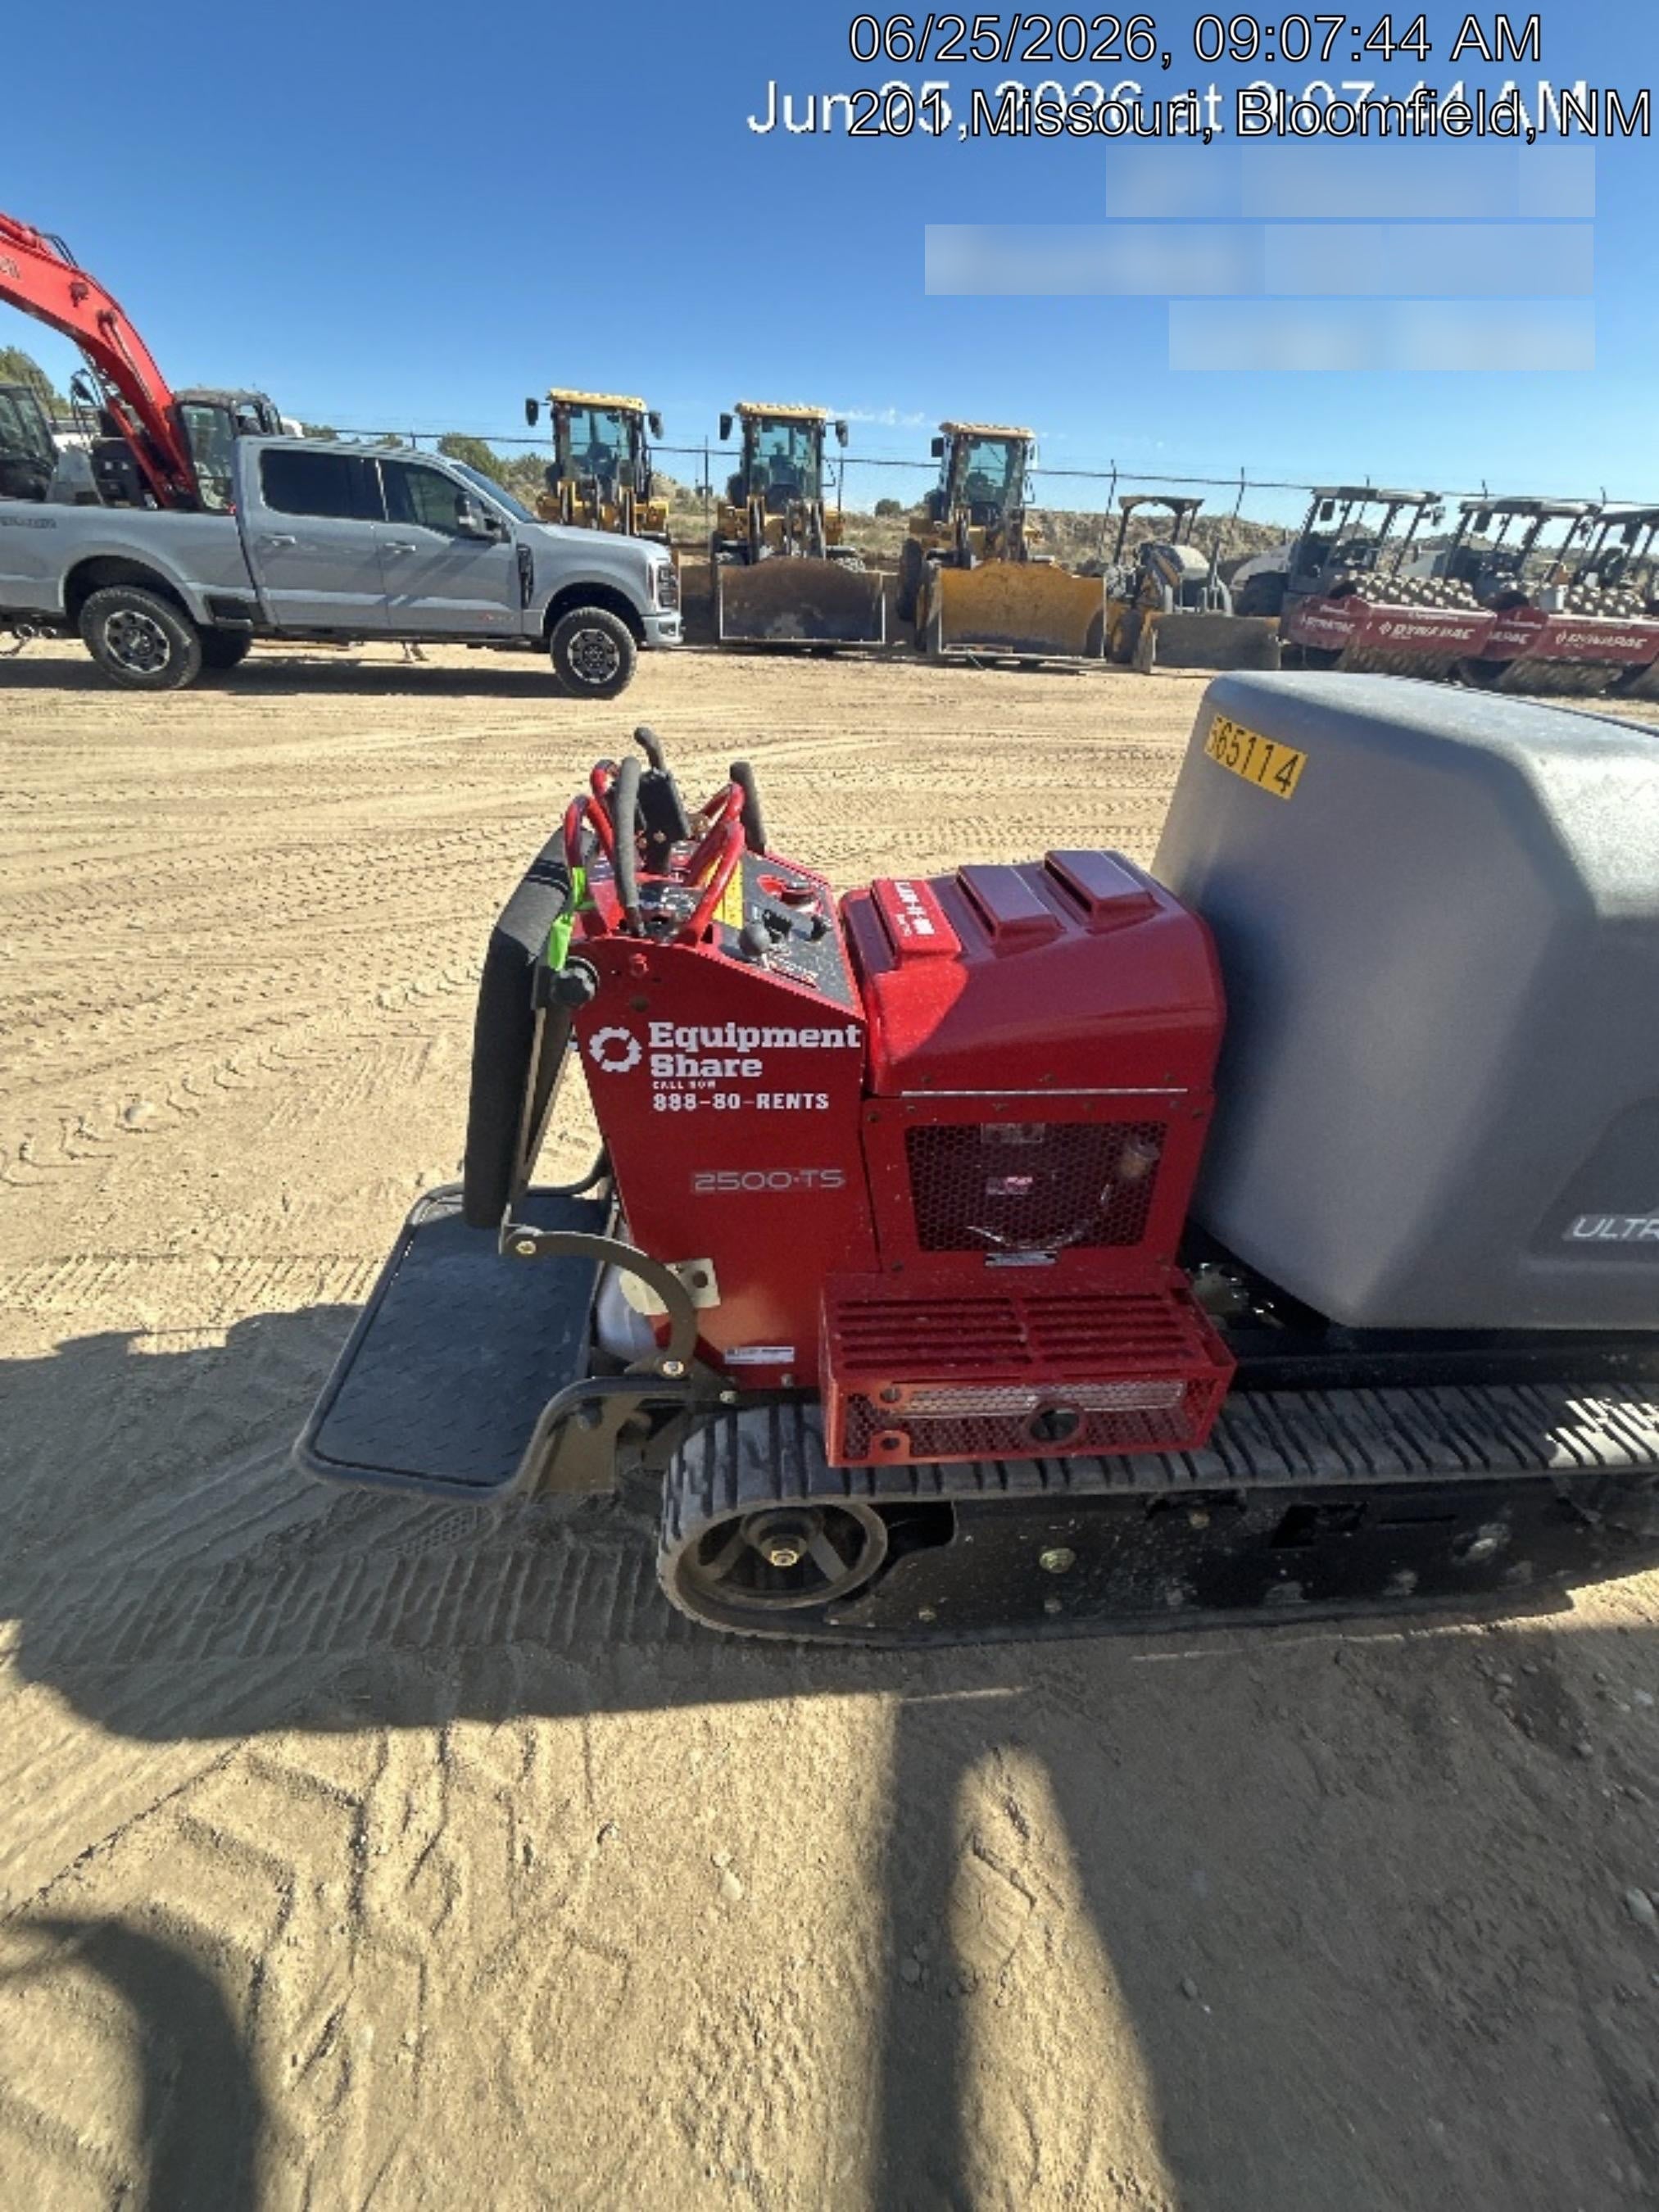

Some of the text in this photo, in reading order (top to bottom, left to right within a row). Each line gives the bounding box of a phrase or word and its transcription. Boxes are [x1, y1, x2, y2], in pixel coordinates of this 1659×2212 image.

[648, 1021, 862, 1053] Equipment
[650, 1053, 764, 1078] Share
[652, 1080, 685, 1090] CALL
[653, 1092, 830, 1112] 888-80-RENTS
